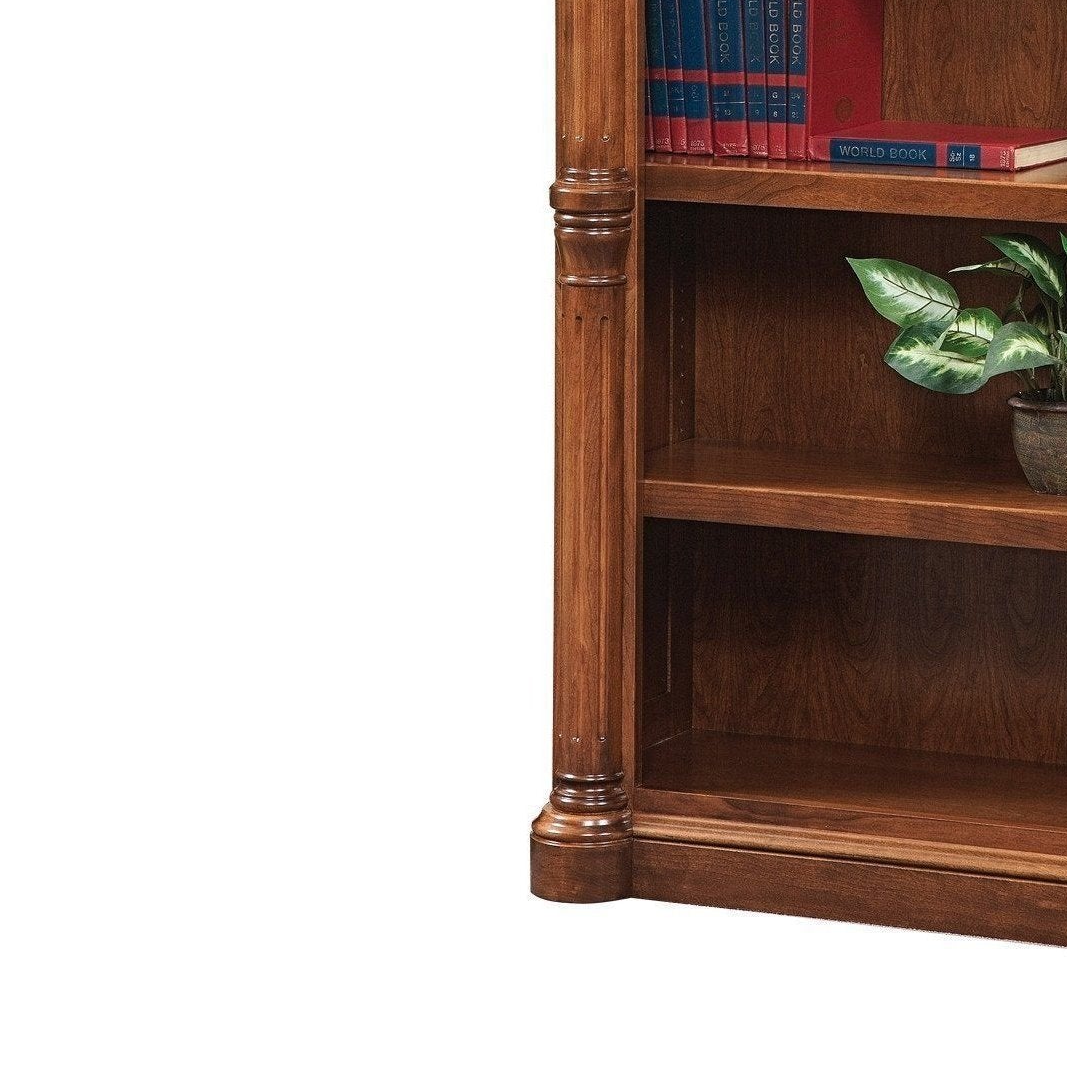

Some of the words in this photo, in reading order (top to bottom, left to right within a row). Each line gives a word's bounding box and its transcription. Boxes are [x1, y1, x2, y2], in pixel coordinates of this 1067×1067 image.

[718, 22, 730, 63] BOOK
[769, 24, 780, 64] BOOK
[791, 24, 802, 65] BOOK
[839, 145, 885, 159] WORLD
[889, 147, 927, 161] BOOK
